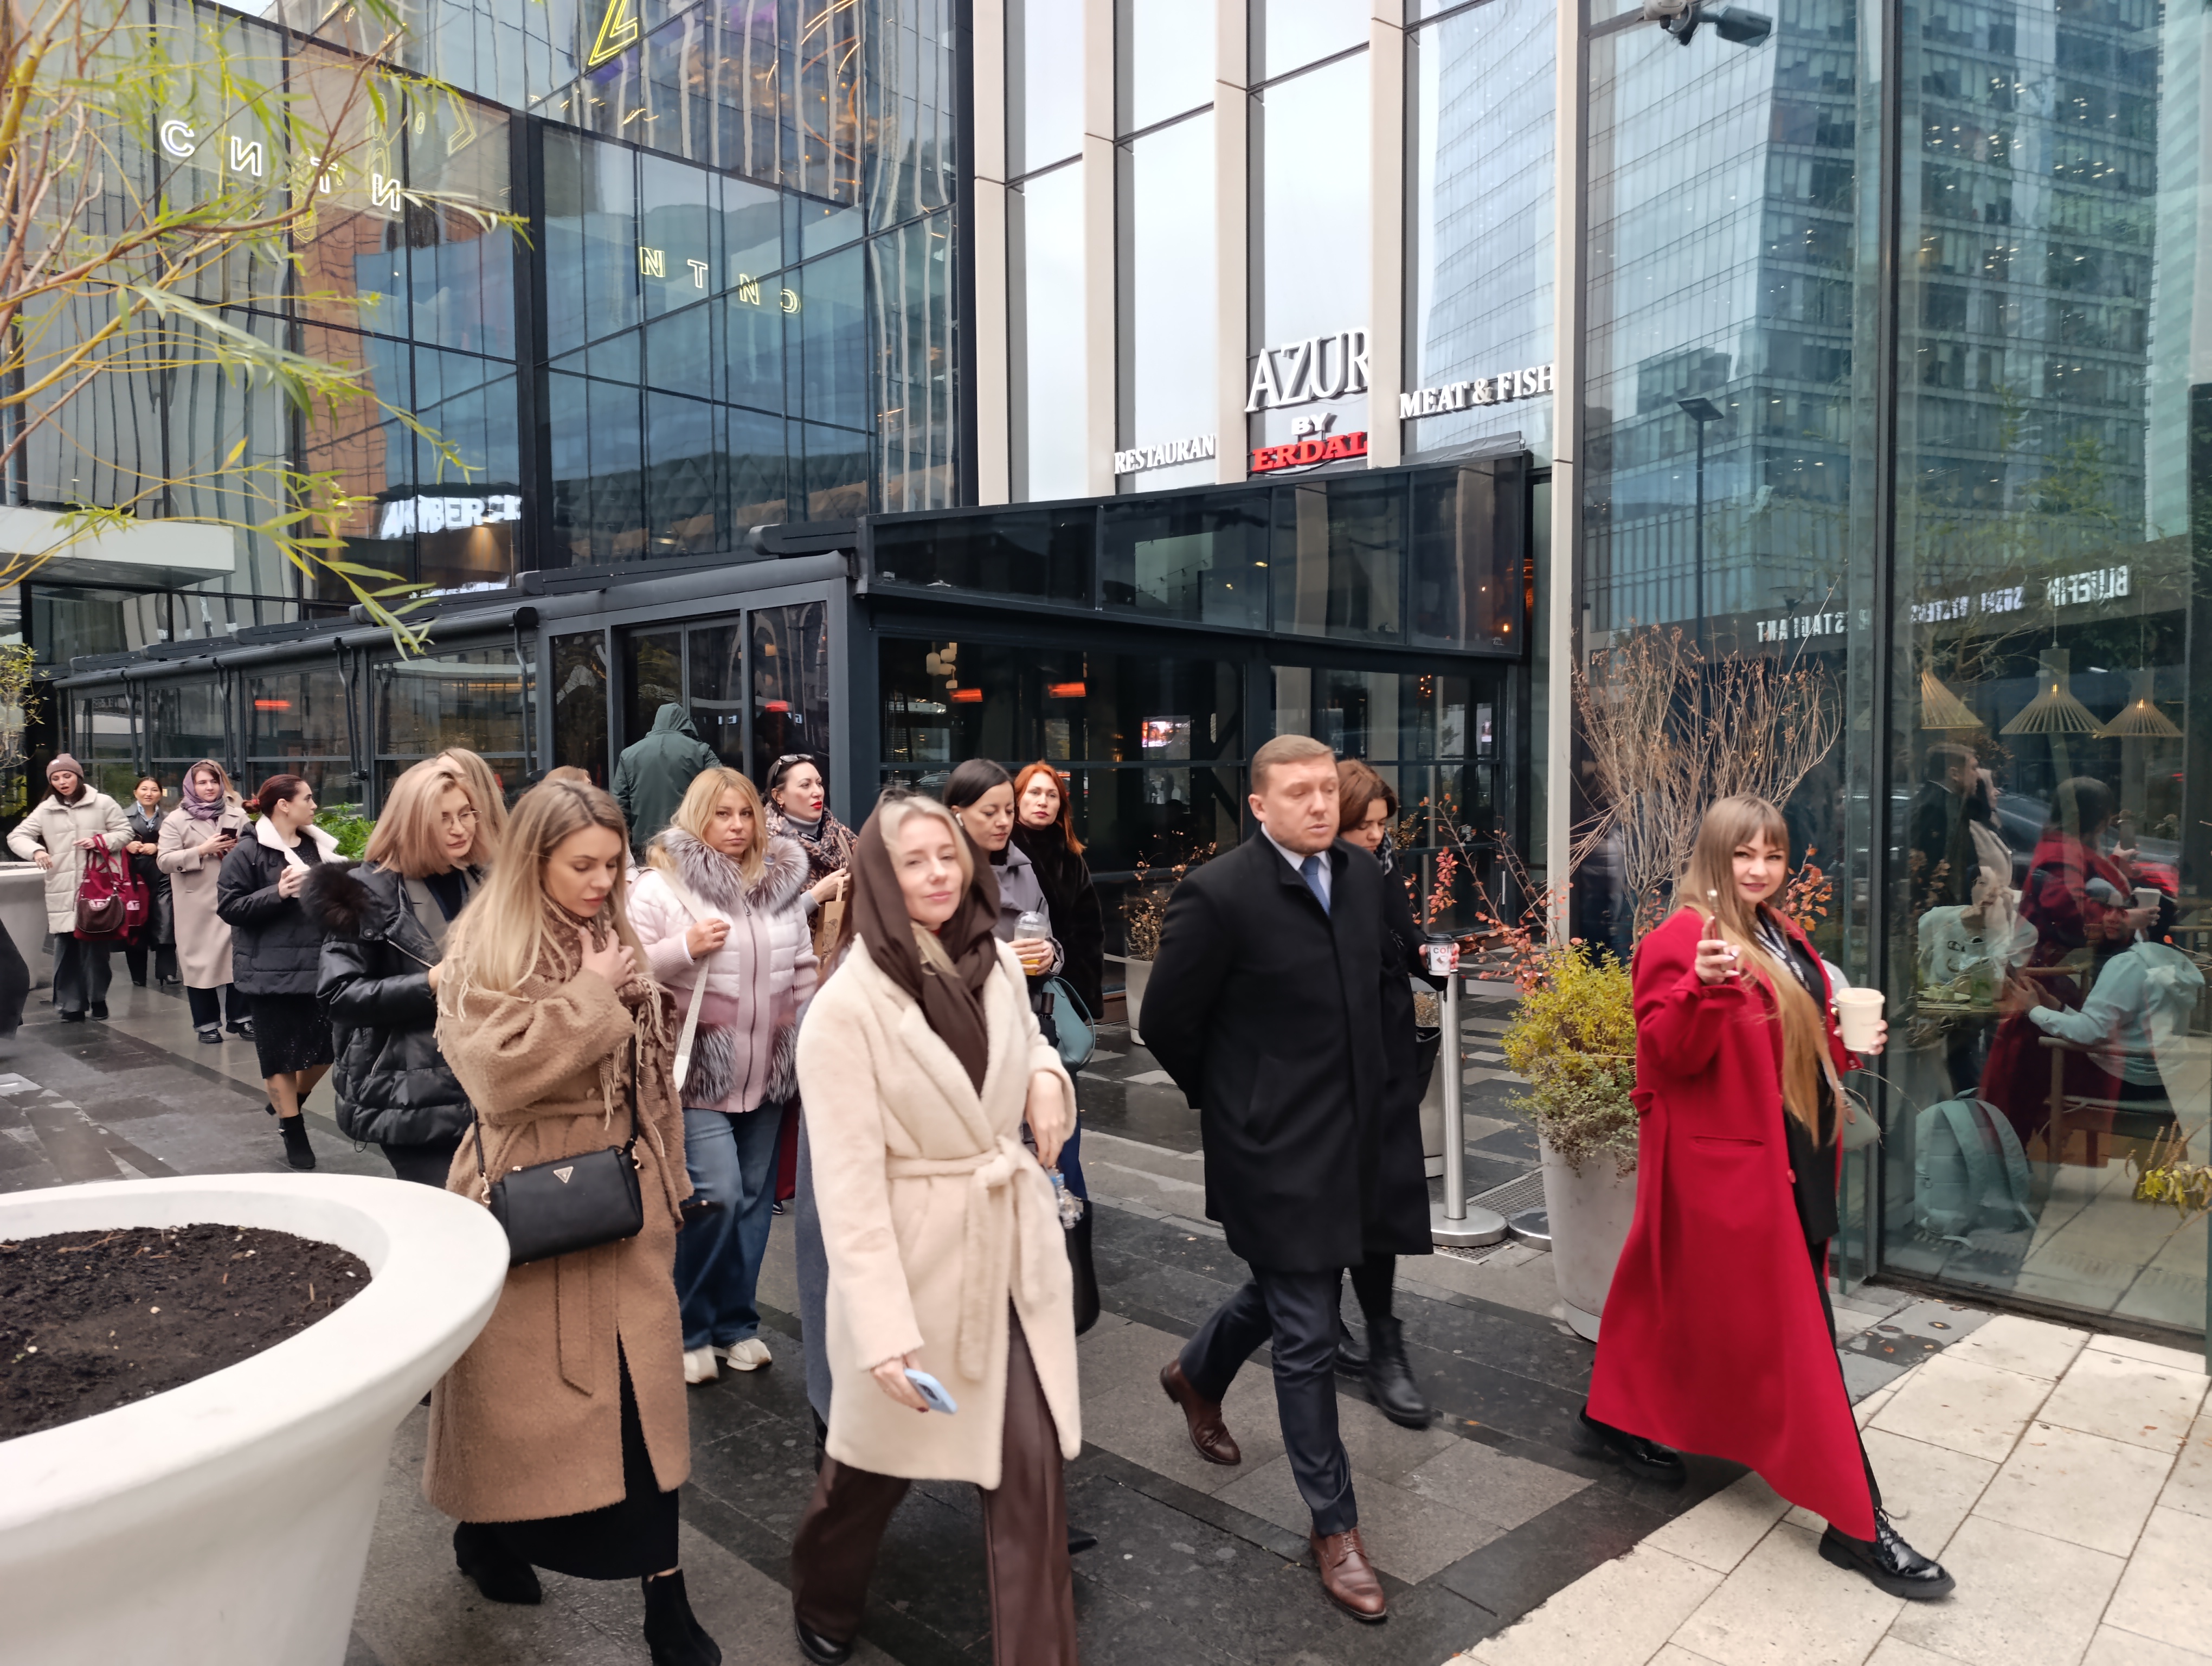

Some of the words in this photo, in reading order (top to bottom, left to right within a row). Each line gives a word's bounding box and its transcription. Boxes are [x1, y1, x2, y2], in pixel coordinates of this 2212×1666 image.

[1244, 327, 1368, 412] AZUR
[1399, 381, 1470, 419] MEAT
[1472, 378, 1495, 404] &
[1497, 364, 1554, 400] FISH
[1291, 413, 1337, 435] BY
[1114, 434, 1216, 475] RESTAURAN
[1252, 431, 1368, 472] ERDAL
